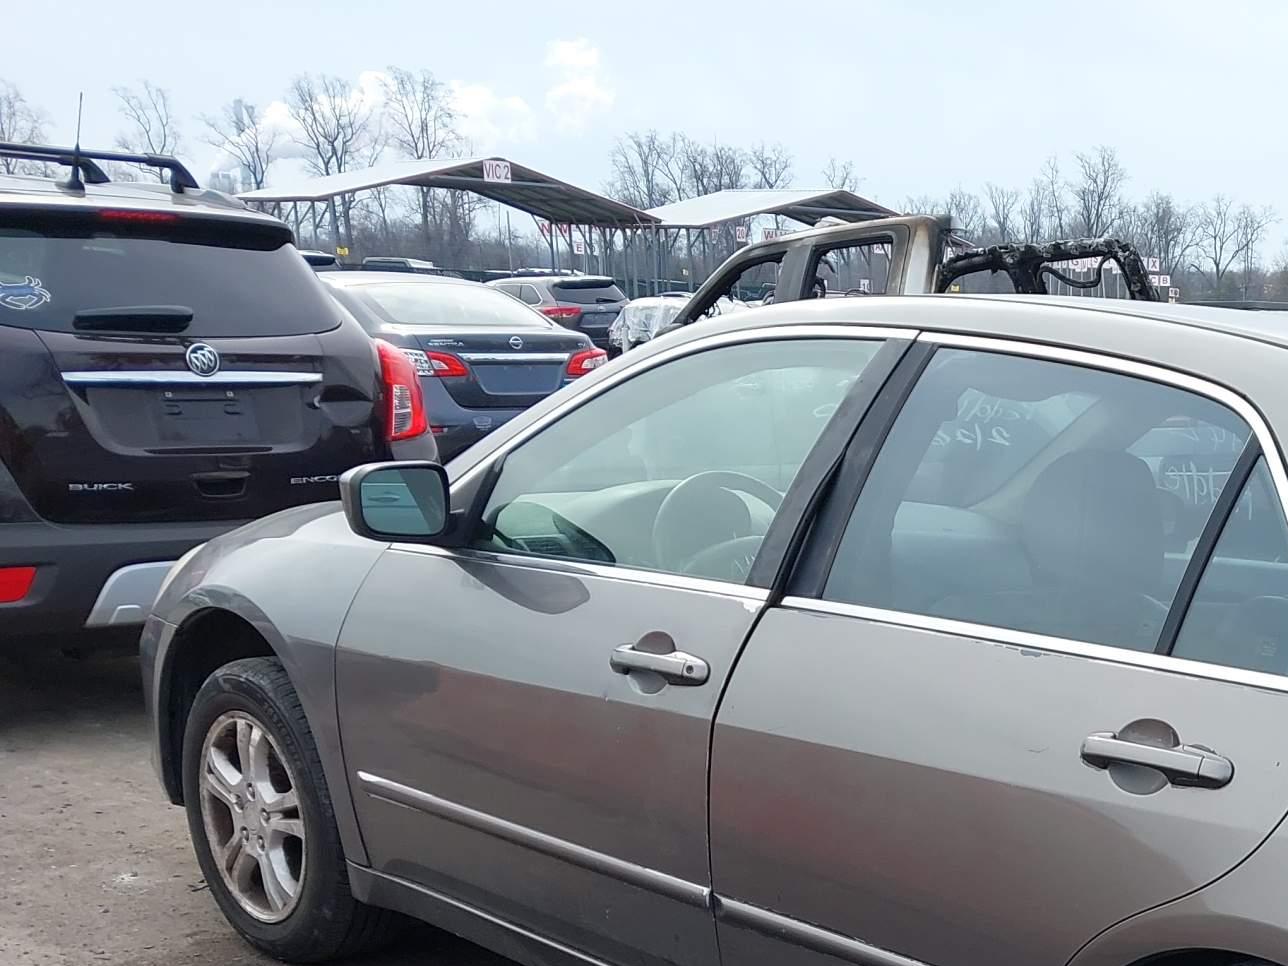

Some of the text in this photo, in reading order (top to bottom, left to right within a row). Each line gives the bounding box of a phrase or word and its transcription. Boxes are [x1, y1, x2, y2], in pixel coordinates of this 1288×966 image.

[484, 162, 510, 180] VIC 2
[1151, 259, 1158, 269] X
[1162, 276, 1169, 285] B
[68, 482, 135, 491] BUICK
